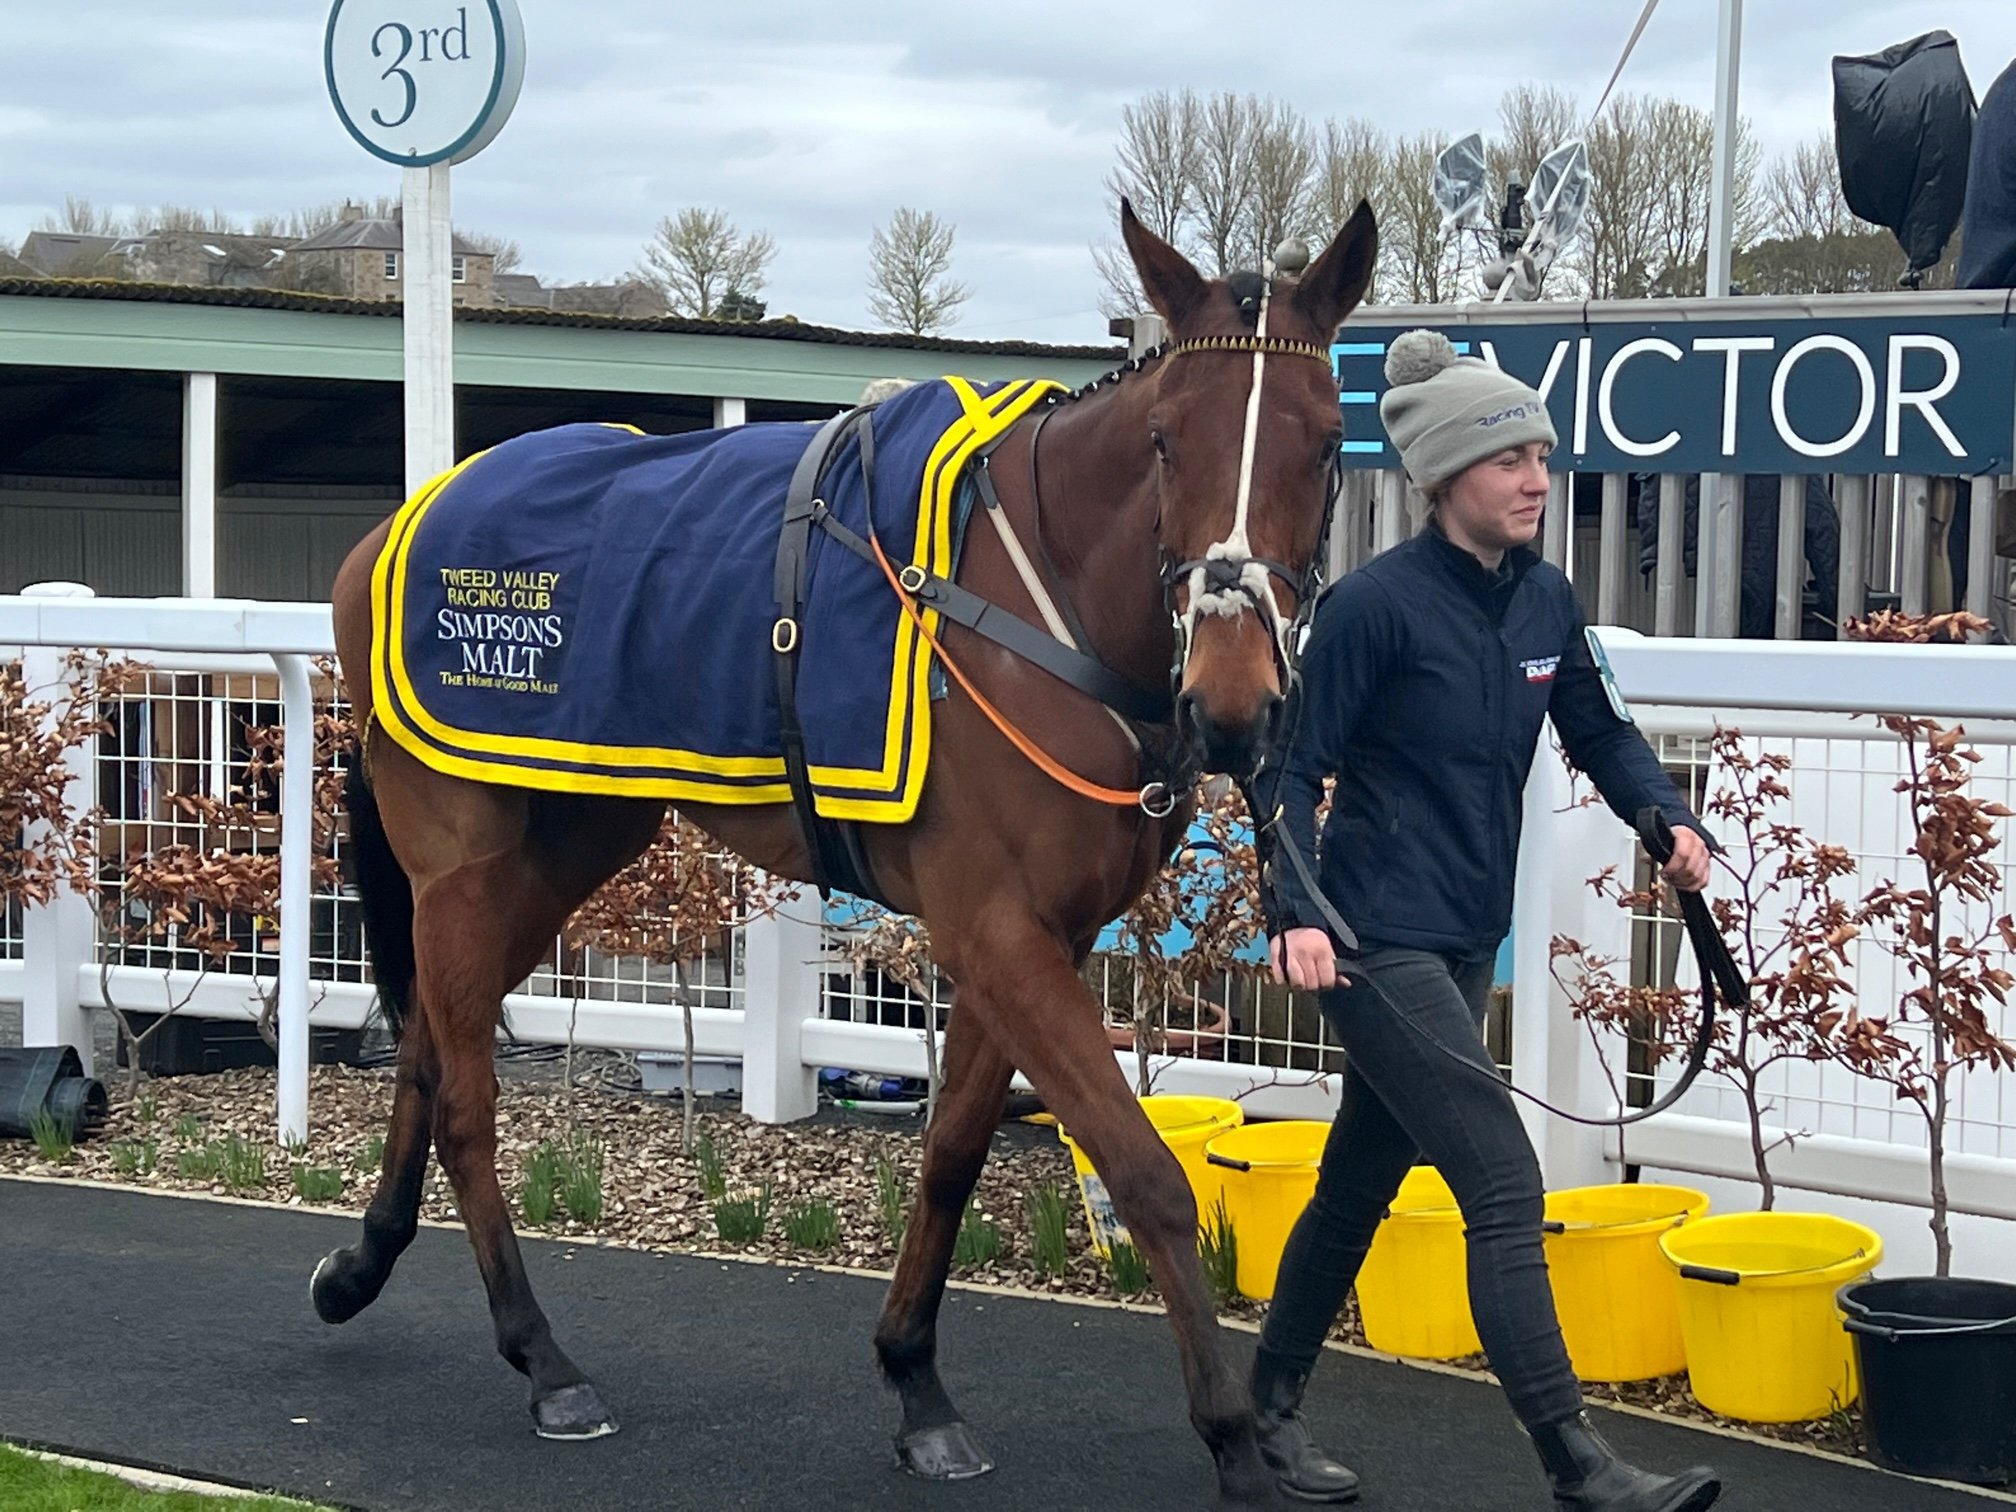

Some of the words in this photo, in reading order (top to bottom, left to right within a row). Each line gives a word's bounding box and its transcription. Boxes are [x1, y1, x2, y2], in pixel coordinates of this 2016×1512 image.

[371, 7, 470, 127] 3rd
[440, 568, 496, 588] TWEED
[502, 571, 560, 591] VALLEY
[447, 587, 507, 608] RACING
[511, 590, 551, 610] CLUB
[437, 608, 562, 648] SIMPSONS
[461, 641, 543, 679] MALT
